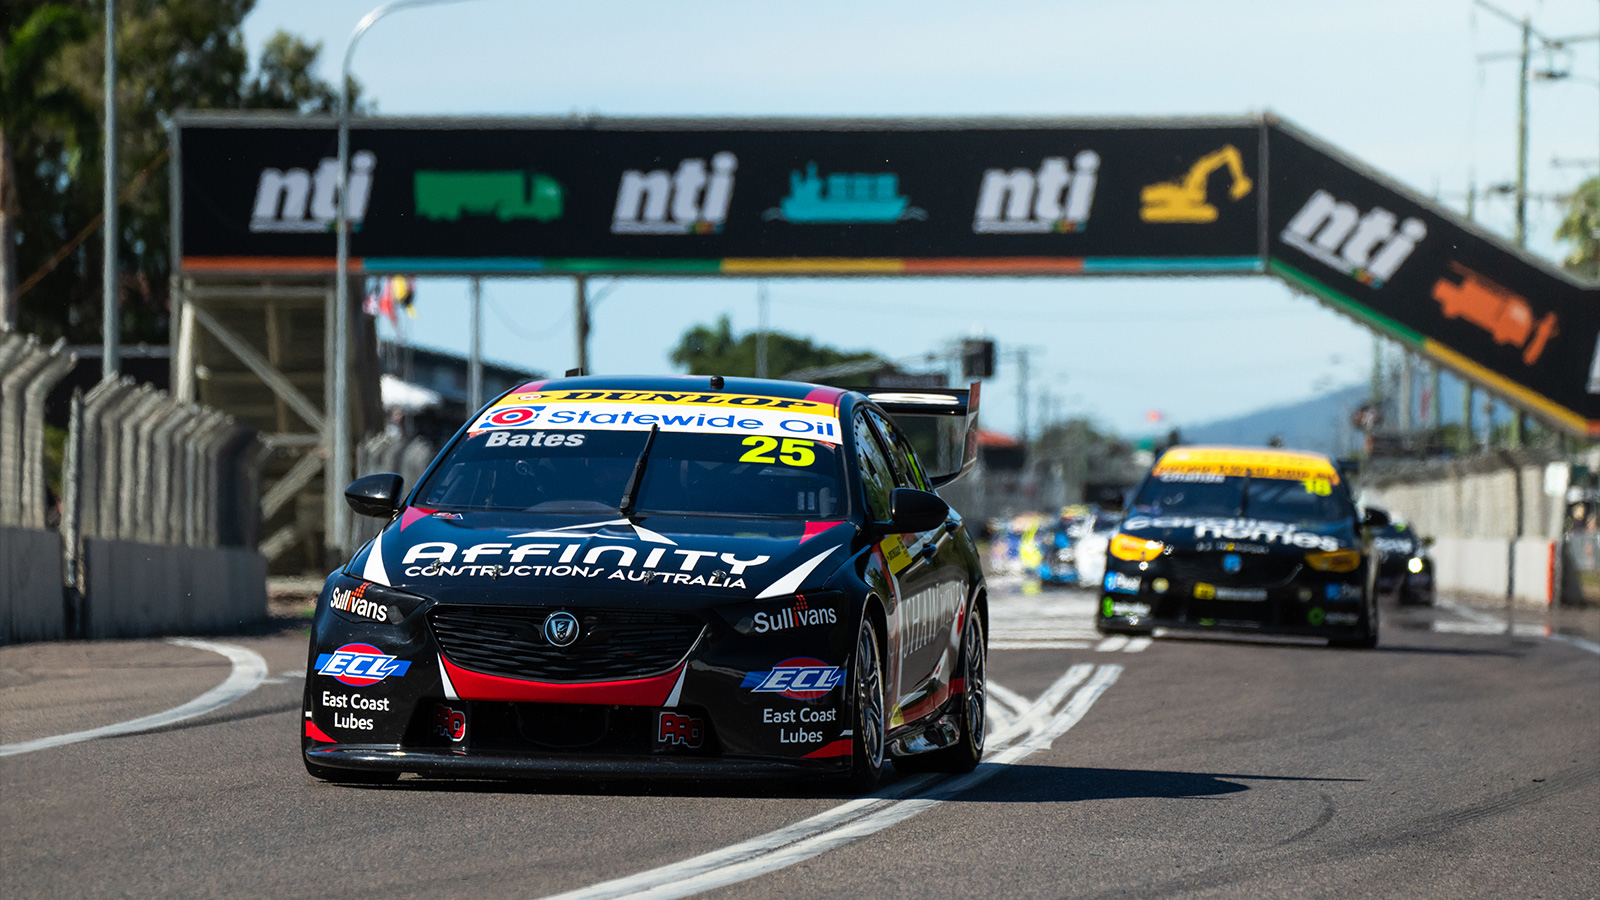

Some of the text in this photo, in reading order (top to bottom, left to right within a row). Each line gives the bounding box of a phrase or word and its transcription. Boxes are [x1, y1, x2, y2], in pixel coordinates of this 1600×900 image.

[252, 150, 377, 219] nti
[613, 150, 738, 221] nti
[975, 150, 1100, 221] nti
[1287, 189, 1427, 282] nti
[556, 391, 817, 409] DUNLOP
[547, 410, 834, 437] Statewide Oil
[485, 431, 586, 448] Bates
[738, 436, 816, 467] 25
[402, 541, 771, 574] AFFINITY
[404, 564, 606, 579] CONSTRUCTIONS
[330, 586, 388, 622] Sullivans
[754, 604, 837, 634] Sullivans
[322, 652, 400, 678] ECL
[755, 666, 841, 692] ECL
[322, 690, 389, 711] East Coast
[334, 712, 374, 731] Lubes
[763, 707, 837, 723] East Coast
[658, 711, 704, 748] PRO
[780, 727, 823, 744] Lubes
